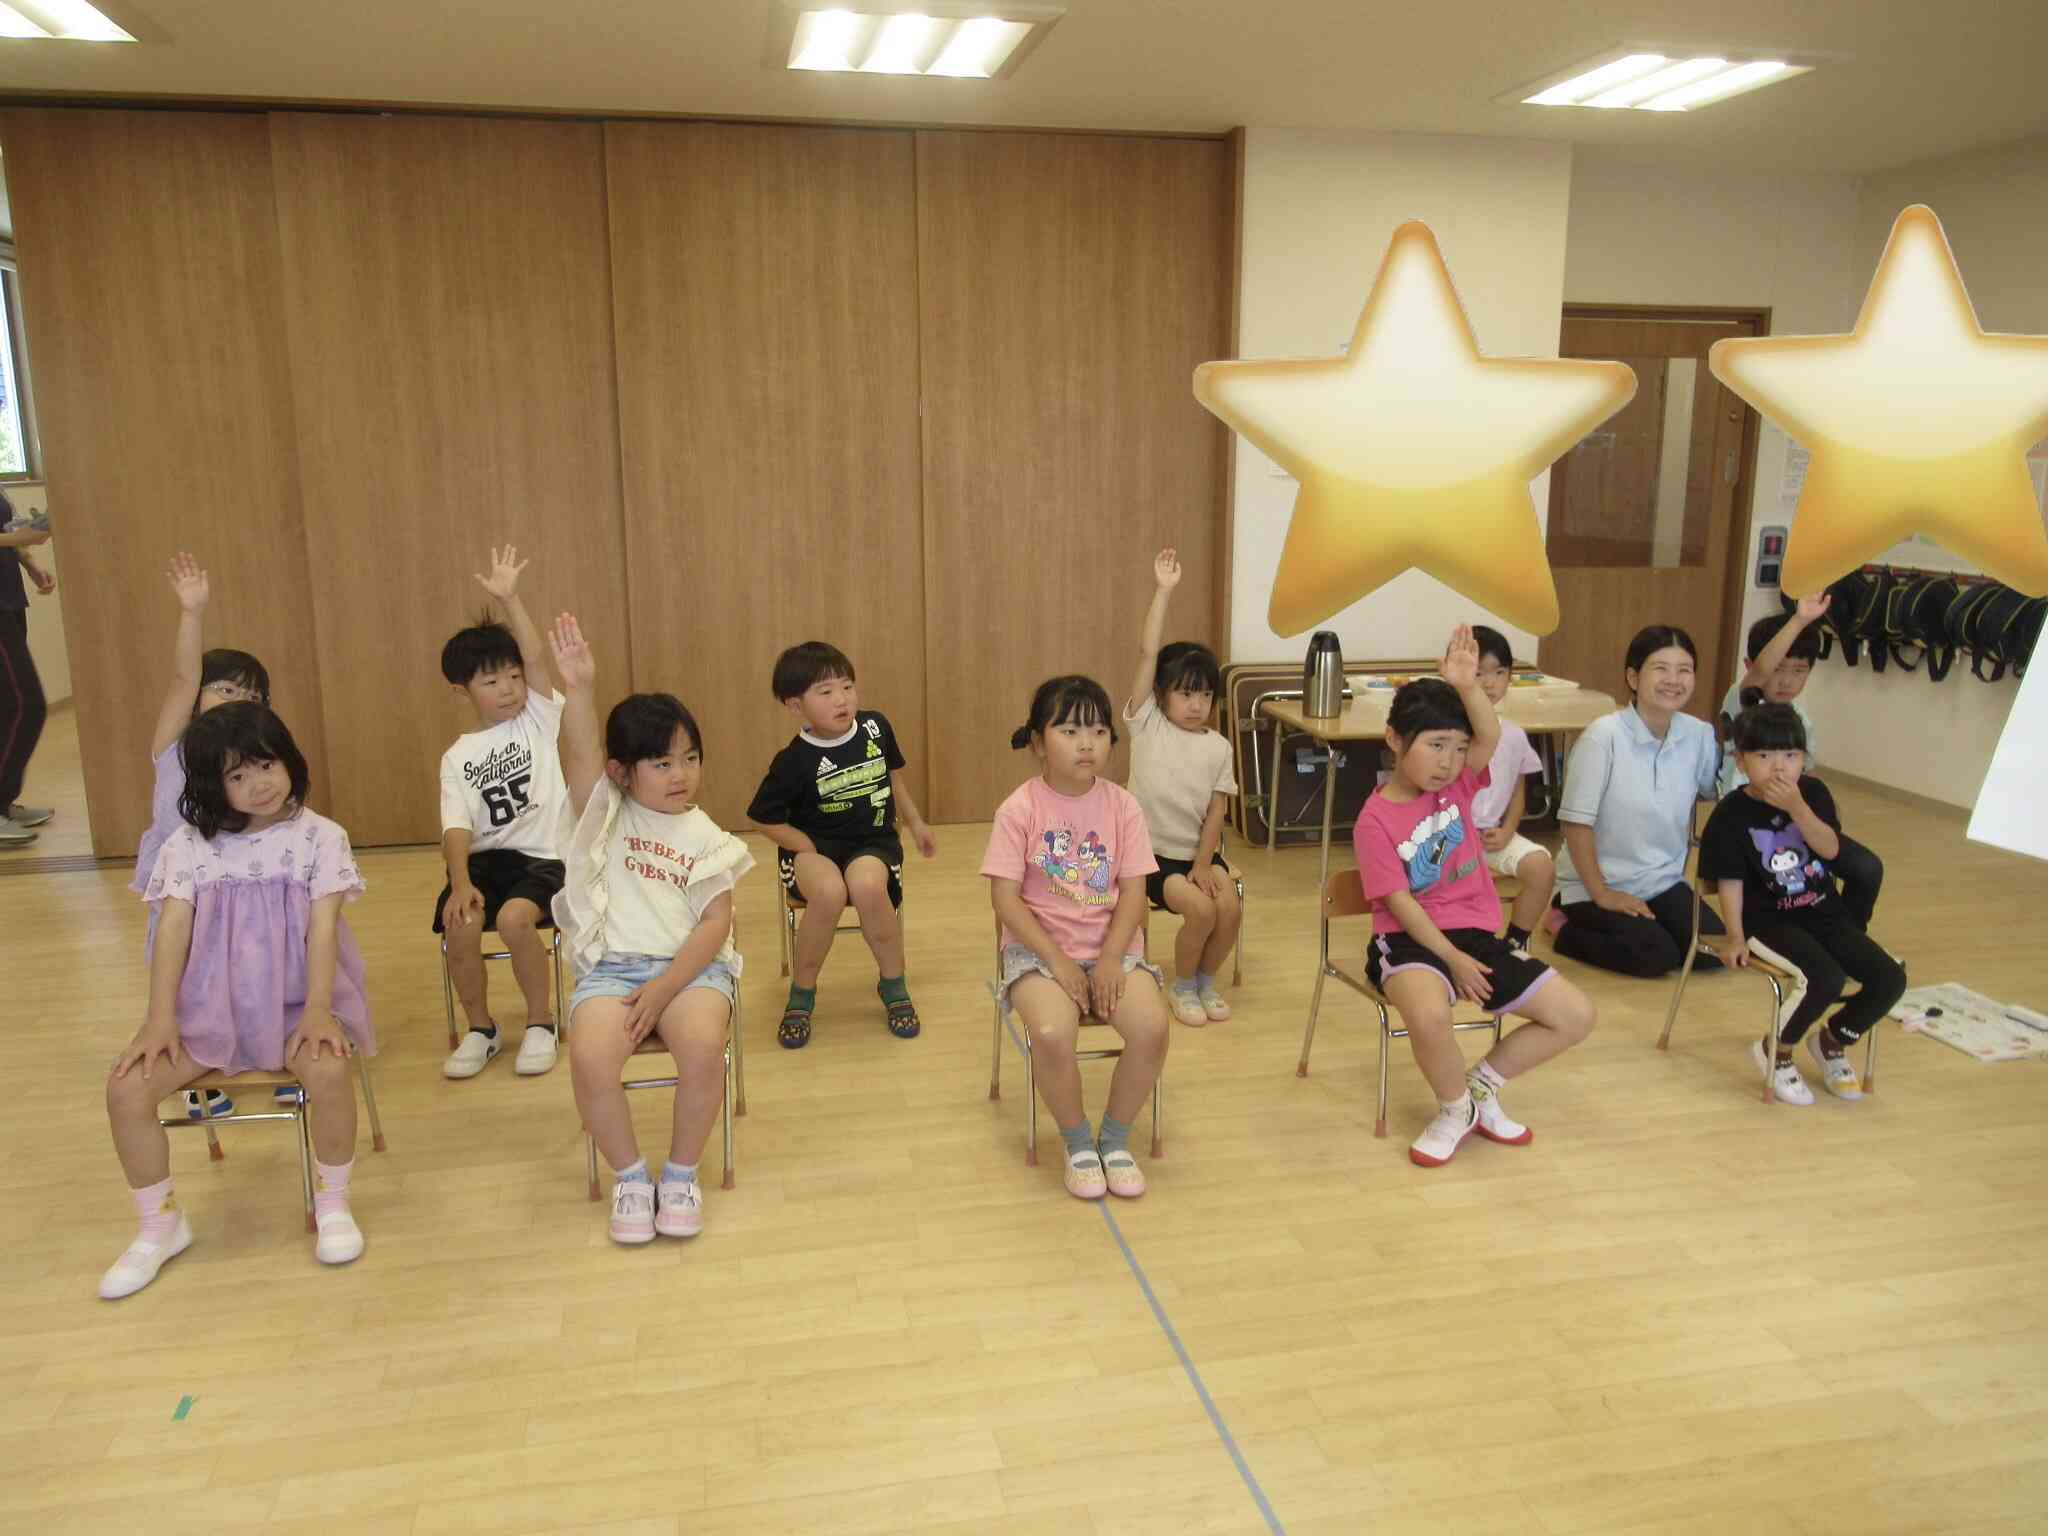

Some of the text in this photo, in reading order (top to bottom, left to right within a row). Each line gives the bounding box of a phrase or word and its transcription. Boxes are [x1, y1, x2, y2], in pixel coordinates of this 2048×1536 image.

[463, 741, 521, 780] Southern
[471, 749, 532, 790] California
[481, 774, 531, 827] 65
